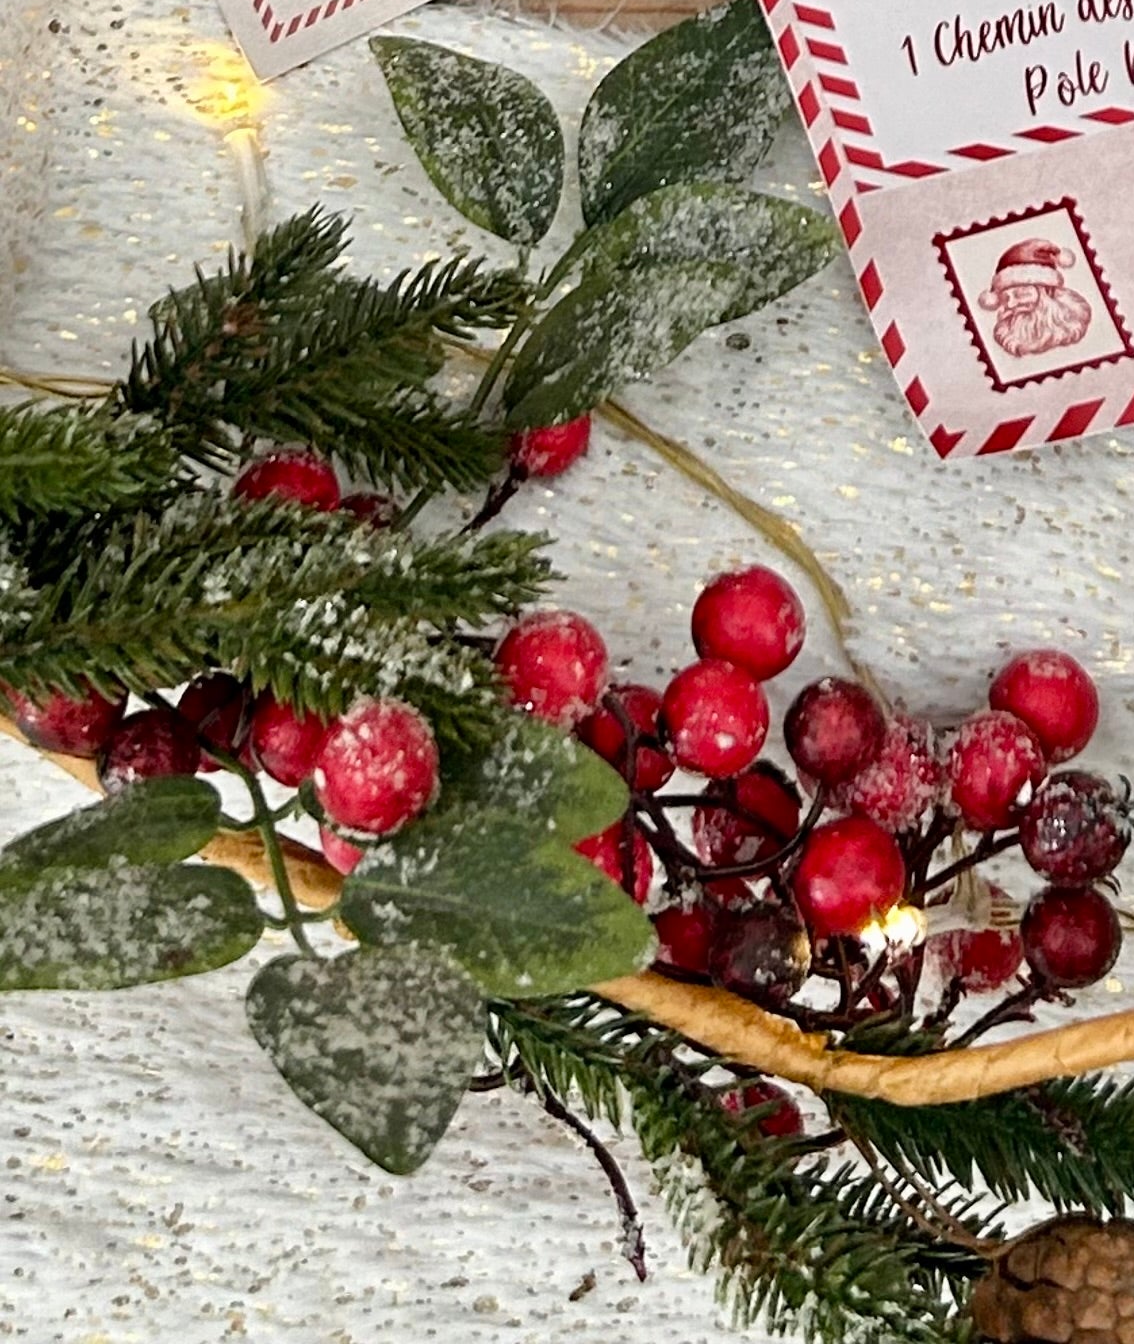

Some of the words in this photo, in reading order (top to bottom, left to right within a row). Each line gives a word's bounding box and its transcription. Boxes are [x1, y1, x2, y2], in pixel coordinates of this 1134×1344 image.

[901, 35, 919, 76] 1
[934, 1, 1065, 65] Chemin
[1025, 50, 1109, 115] Pôle
